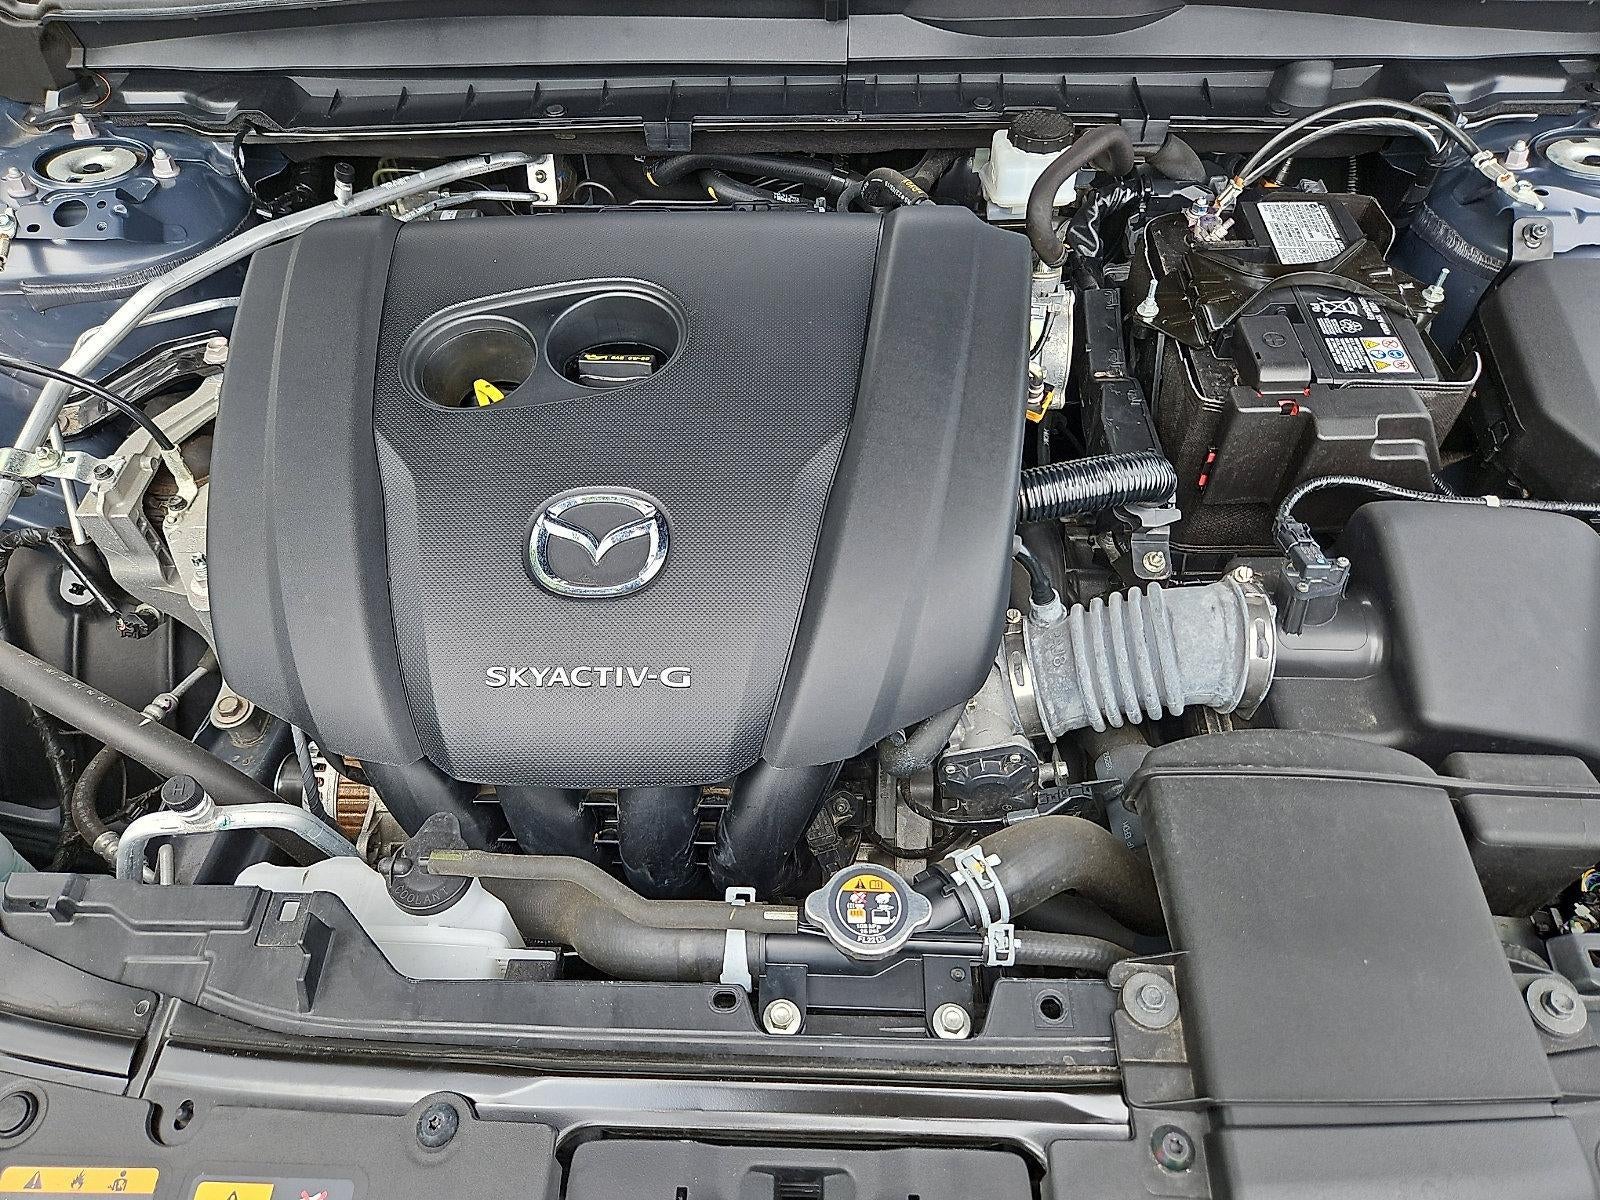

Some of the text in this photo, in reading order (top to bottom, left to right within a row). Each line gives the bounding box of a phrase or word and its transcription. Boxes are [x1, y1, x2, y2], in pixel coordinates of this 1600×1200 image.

[485, 666, 692, 689] SKYACTIV-G
[172, 783, 186, 796] H
[394, 884, 449, 905] COOLANT
[857, 935, 876, 943] FL22
